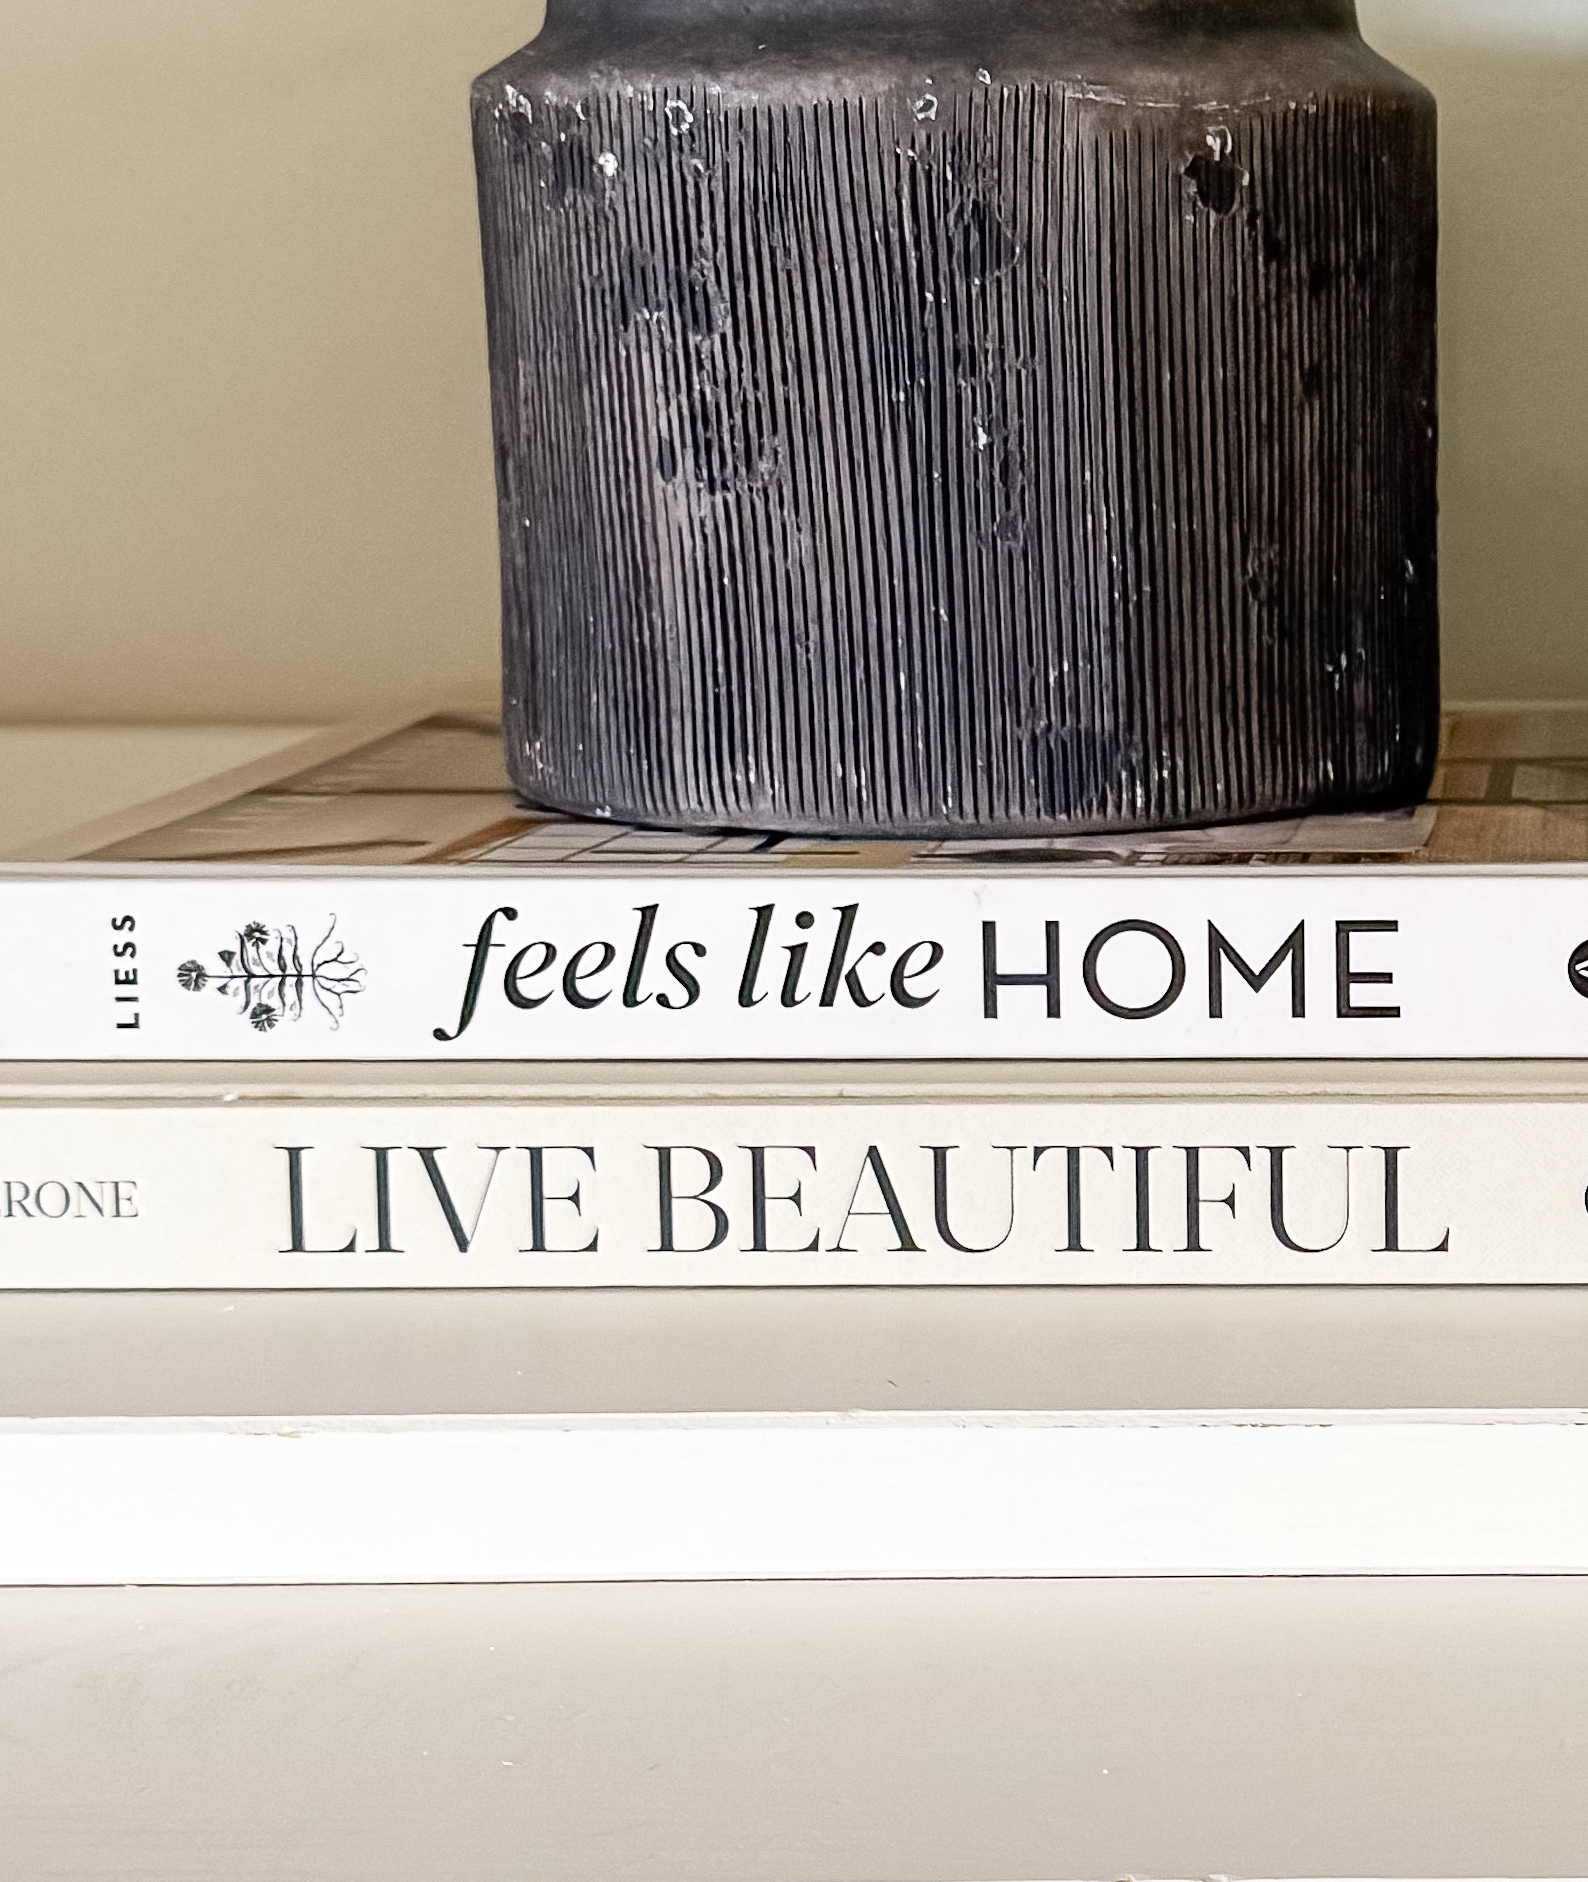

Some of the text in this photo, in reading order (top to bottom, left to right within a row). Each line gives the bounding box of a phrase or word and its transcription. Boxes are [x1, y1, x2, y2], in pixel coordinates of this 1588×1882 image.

[109, 913, 141, 1030] LIESS
[432, 902, 1402, 1042] feels like HOME
[0, 1180, 139, 1219] RONE
[273, 1144, 1450, 1254] LIVE BEAUTIFUL
